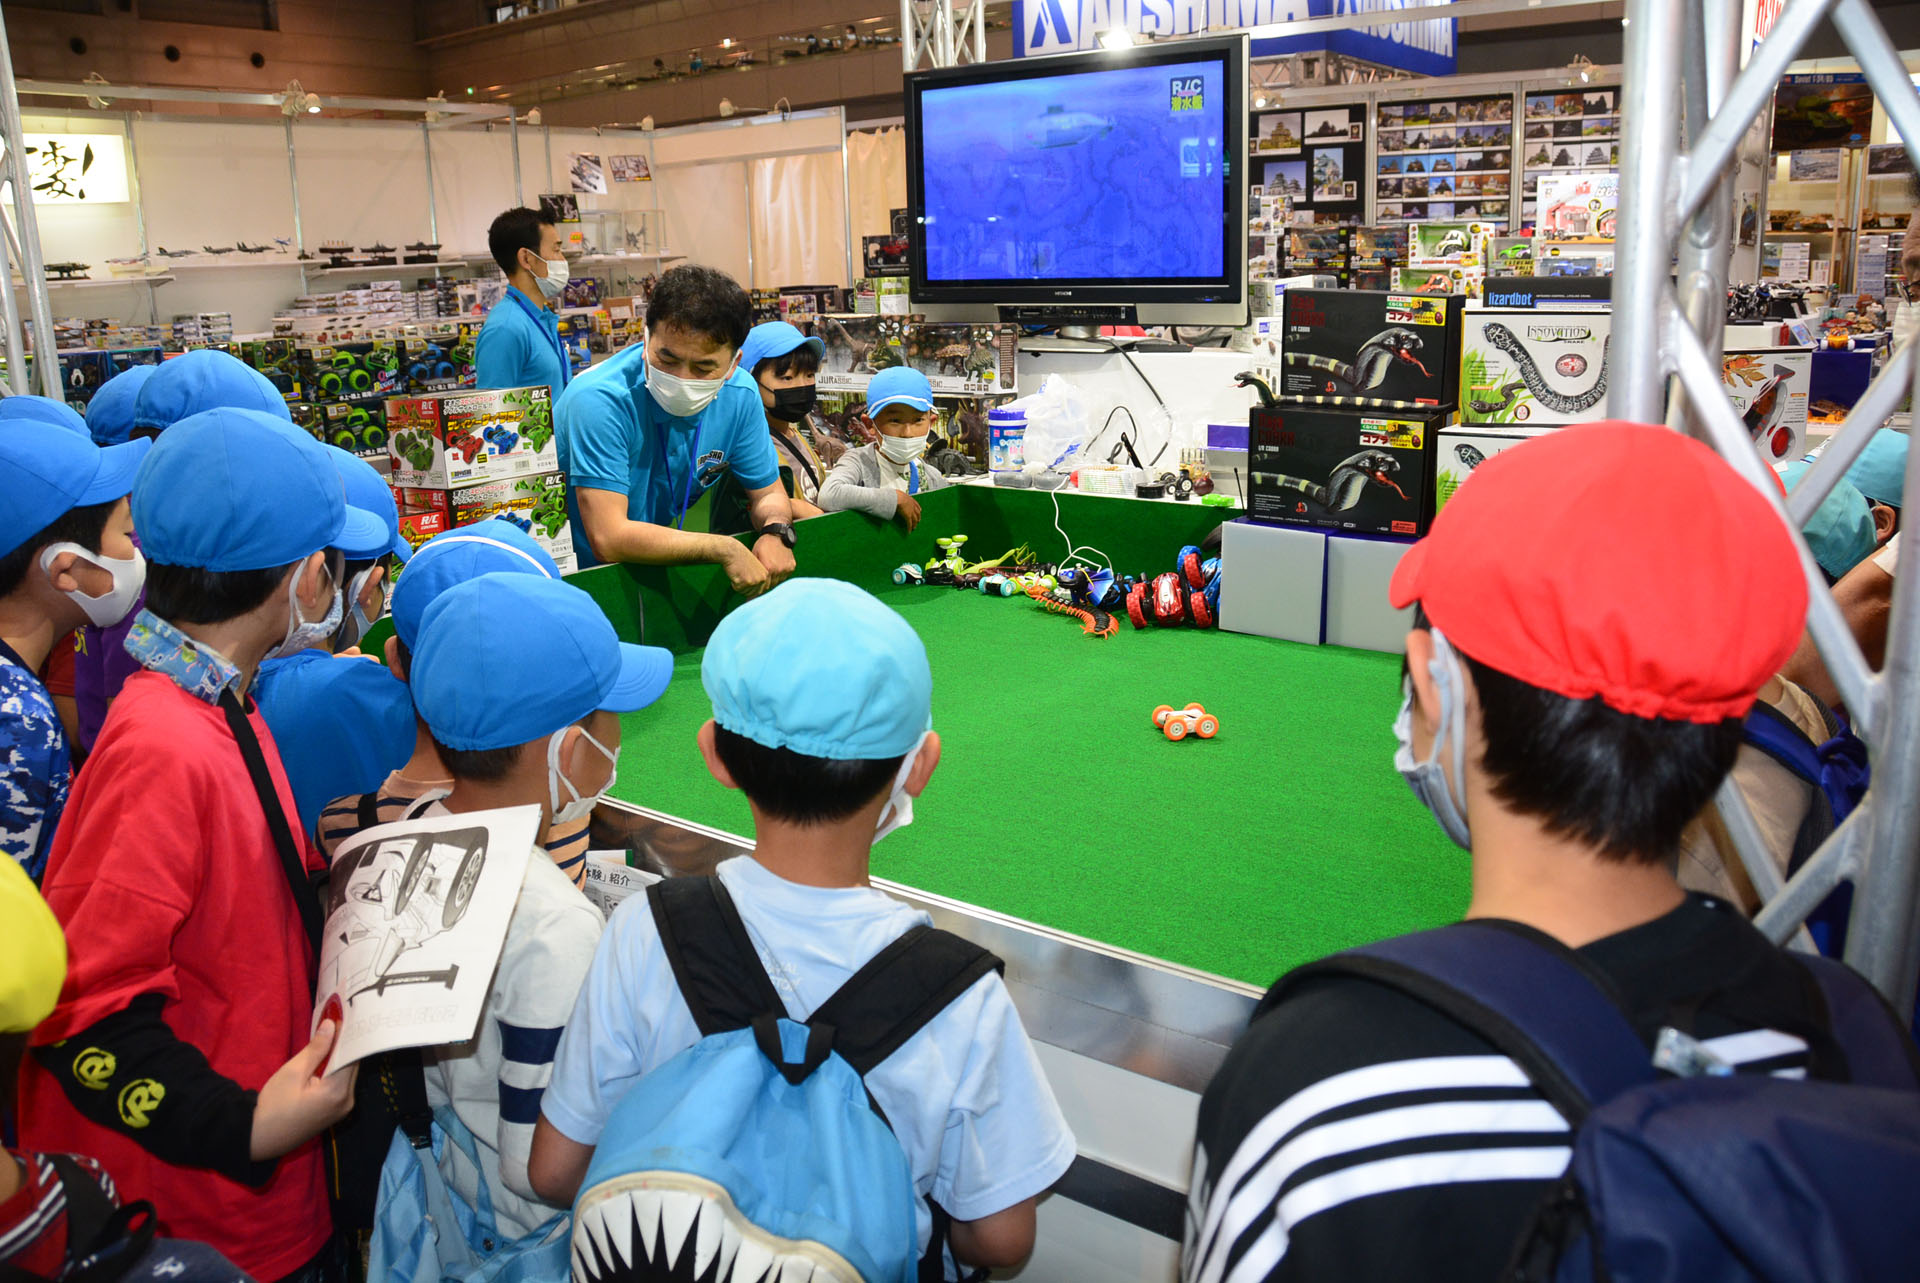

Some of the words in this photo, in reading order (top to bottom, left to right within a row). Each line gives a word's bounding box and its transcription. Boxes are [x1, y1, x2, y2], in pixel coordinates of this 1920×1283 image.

[1079, 0, 1309, 50] ASHIMA
[1172, 79, 1202, 95] R/C
[1488, 292, 1532, 306] lizardbot
[818, 375, 852, 384] JURASSIC
[532, 389, 548, 399] R/C
[546, 476, 563, 485] R/C
[421, 514, 440, 525] R/C
